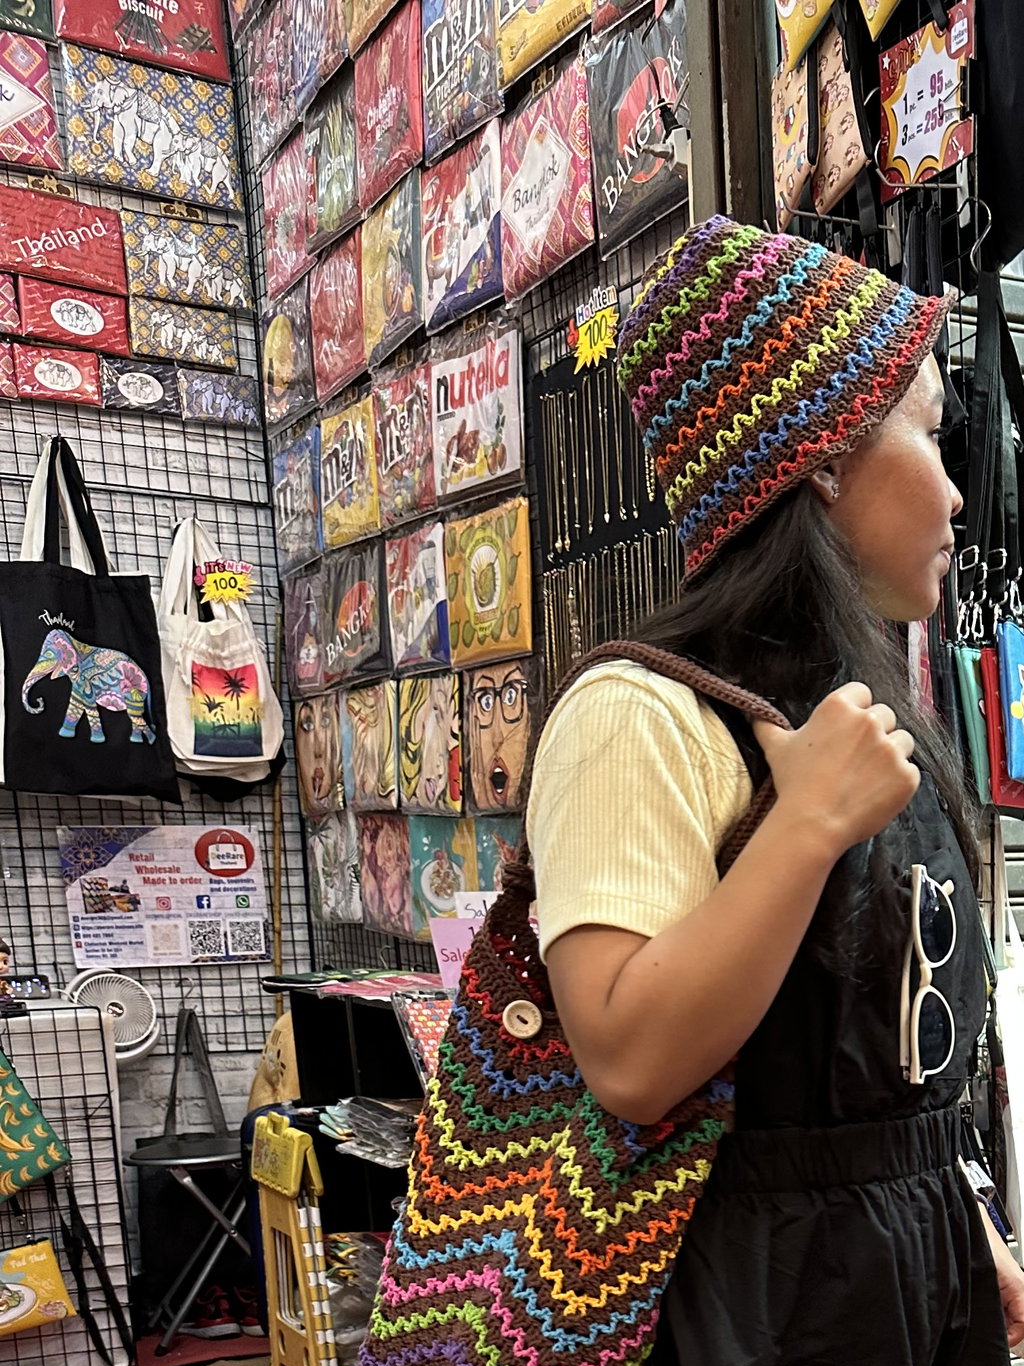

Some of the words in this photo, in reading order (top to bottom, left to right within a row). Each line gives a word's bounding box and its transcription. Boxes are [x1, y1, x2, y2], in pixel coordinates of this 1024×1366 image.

[118, 0, 165, 24] Biscuit
[903, 93, 908, 115] 1
[930, 69, 944, 98] 95
[901, 124, 908, 146] 3
[11, 217, 108, 259] Thailand
[585, 314, 608, 349] 100
[436, 335, 510, 413] nutella
[225, 560, 252, 574] NEW
[129, 852, 155, 863] Retail
[210, 851, 245, 861] DeeRare
[134, 864, 181, 875] Wholesale
[142, 876, 168, 886] Made
[169, 876, 178, 885] to
[179, 876, 203, 885] order
